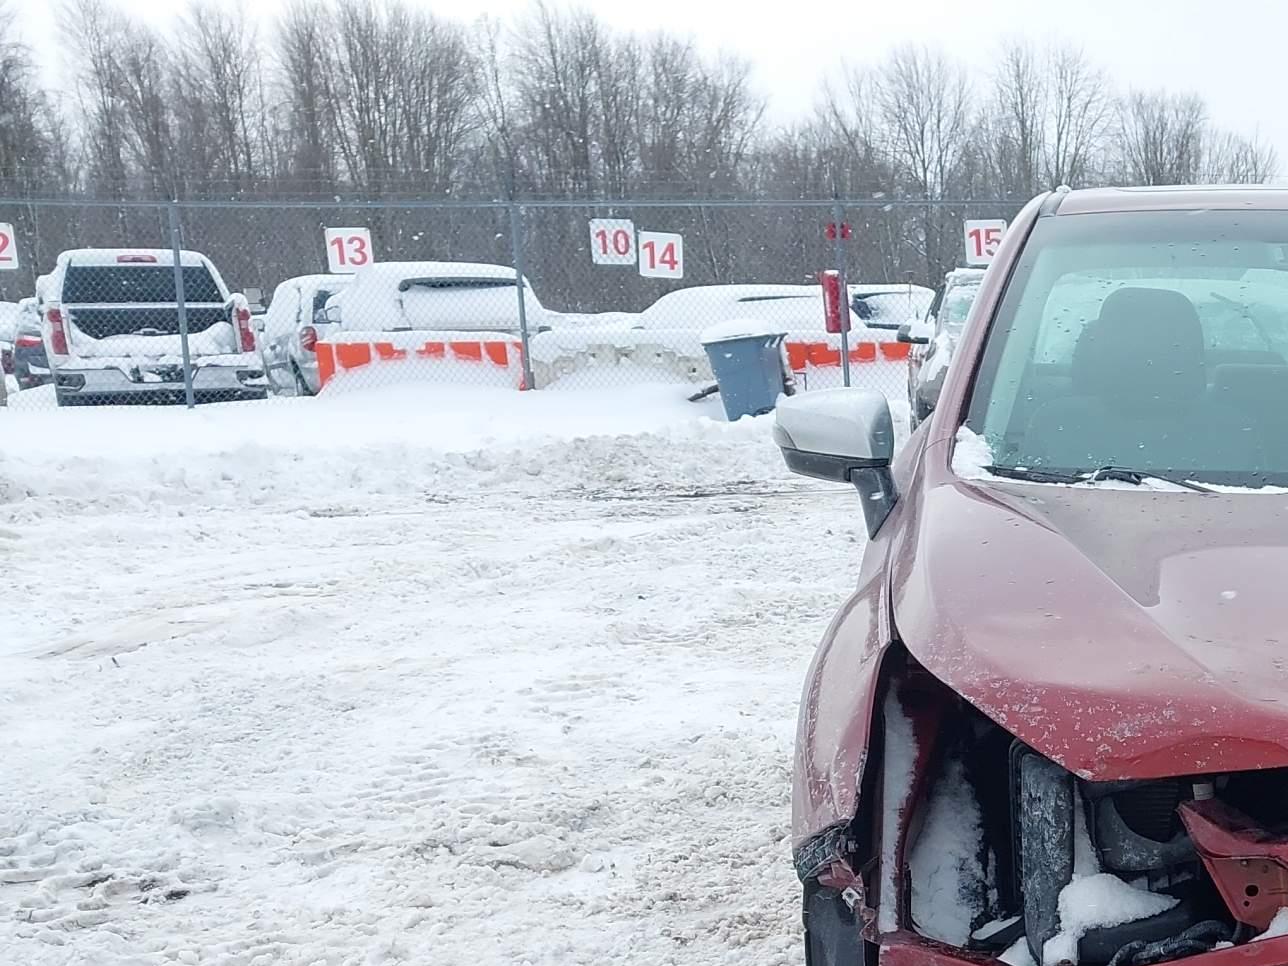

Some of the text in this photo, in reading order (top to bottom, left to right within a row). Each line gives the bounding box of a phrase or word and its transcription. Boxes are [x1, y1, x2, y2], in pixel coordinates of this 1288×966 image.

[330, 236, 368, 266] 13
[595, 229, 630, 256] 10
[642, 240, 679, 271] 14
[968, 228, 1001, 257] 15
